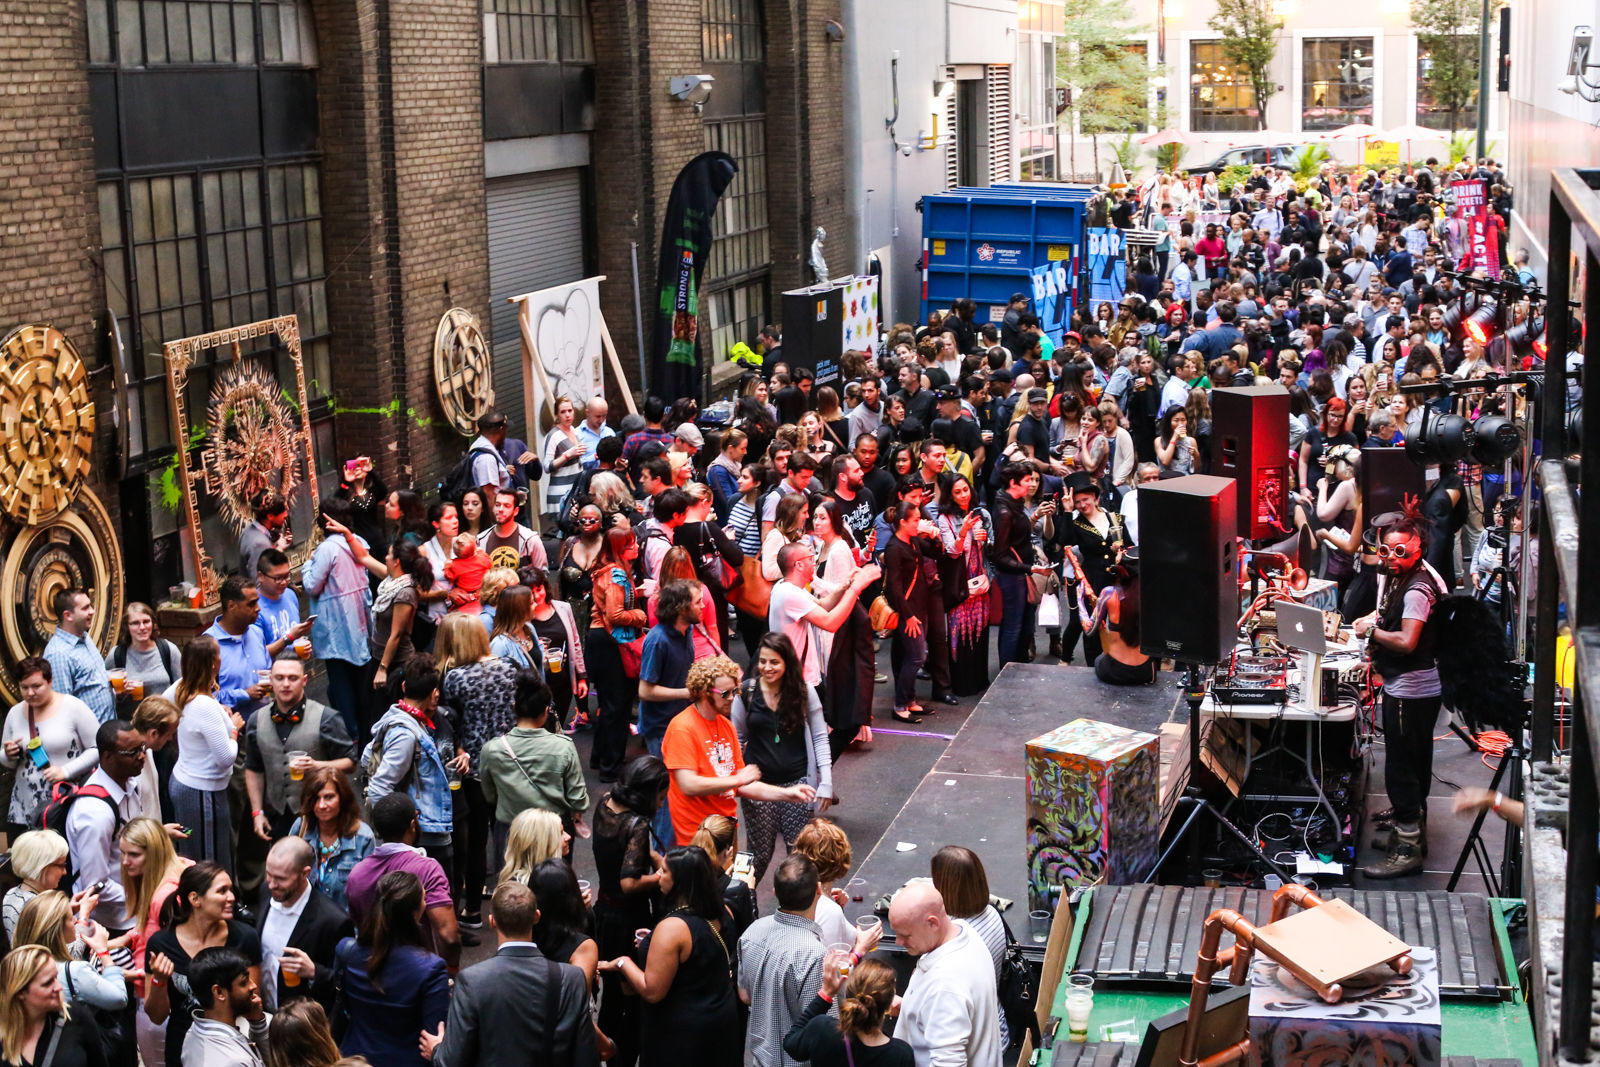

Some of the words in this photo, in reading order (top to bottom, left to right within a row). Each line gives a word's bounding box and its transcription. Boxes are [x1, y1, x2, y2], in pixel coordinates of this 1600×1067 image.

[1452, 183, 1483, 196] DRINK
[1455, 196, 1483, 206] ICKETS
[1089, 234, 1120, 256] BAR
[677, 269, 689, 310] STRONG
[1033, 267, 1068, 301] BAR
[852, 501, 870, 519] What
